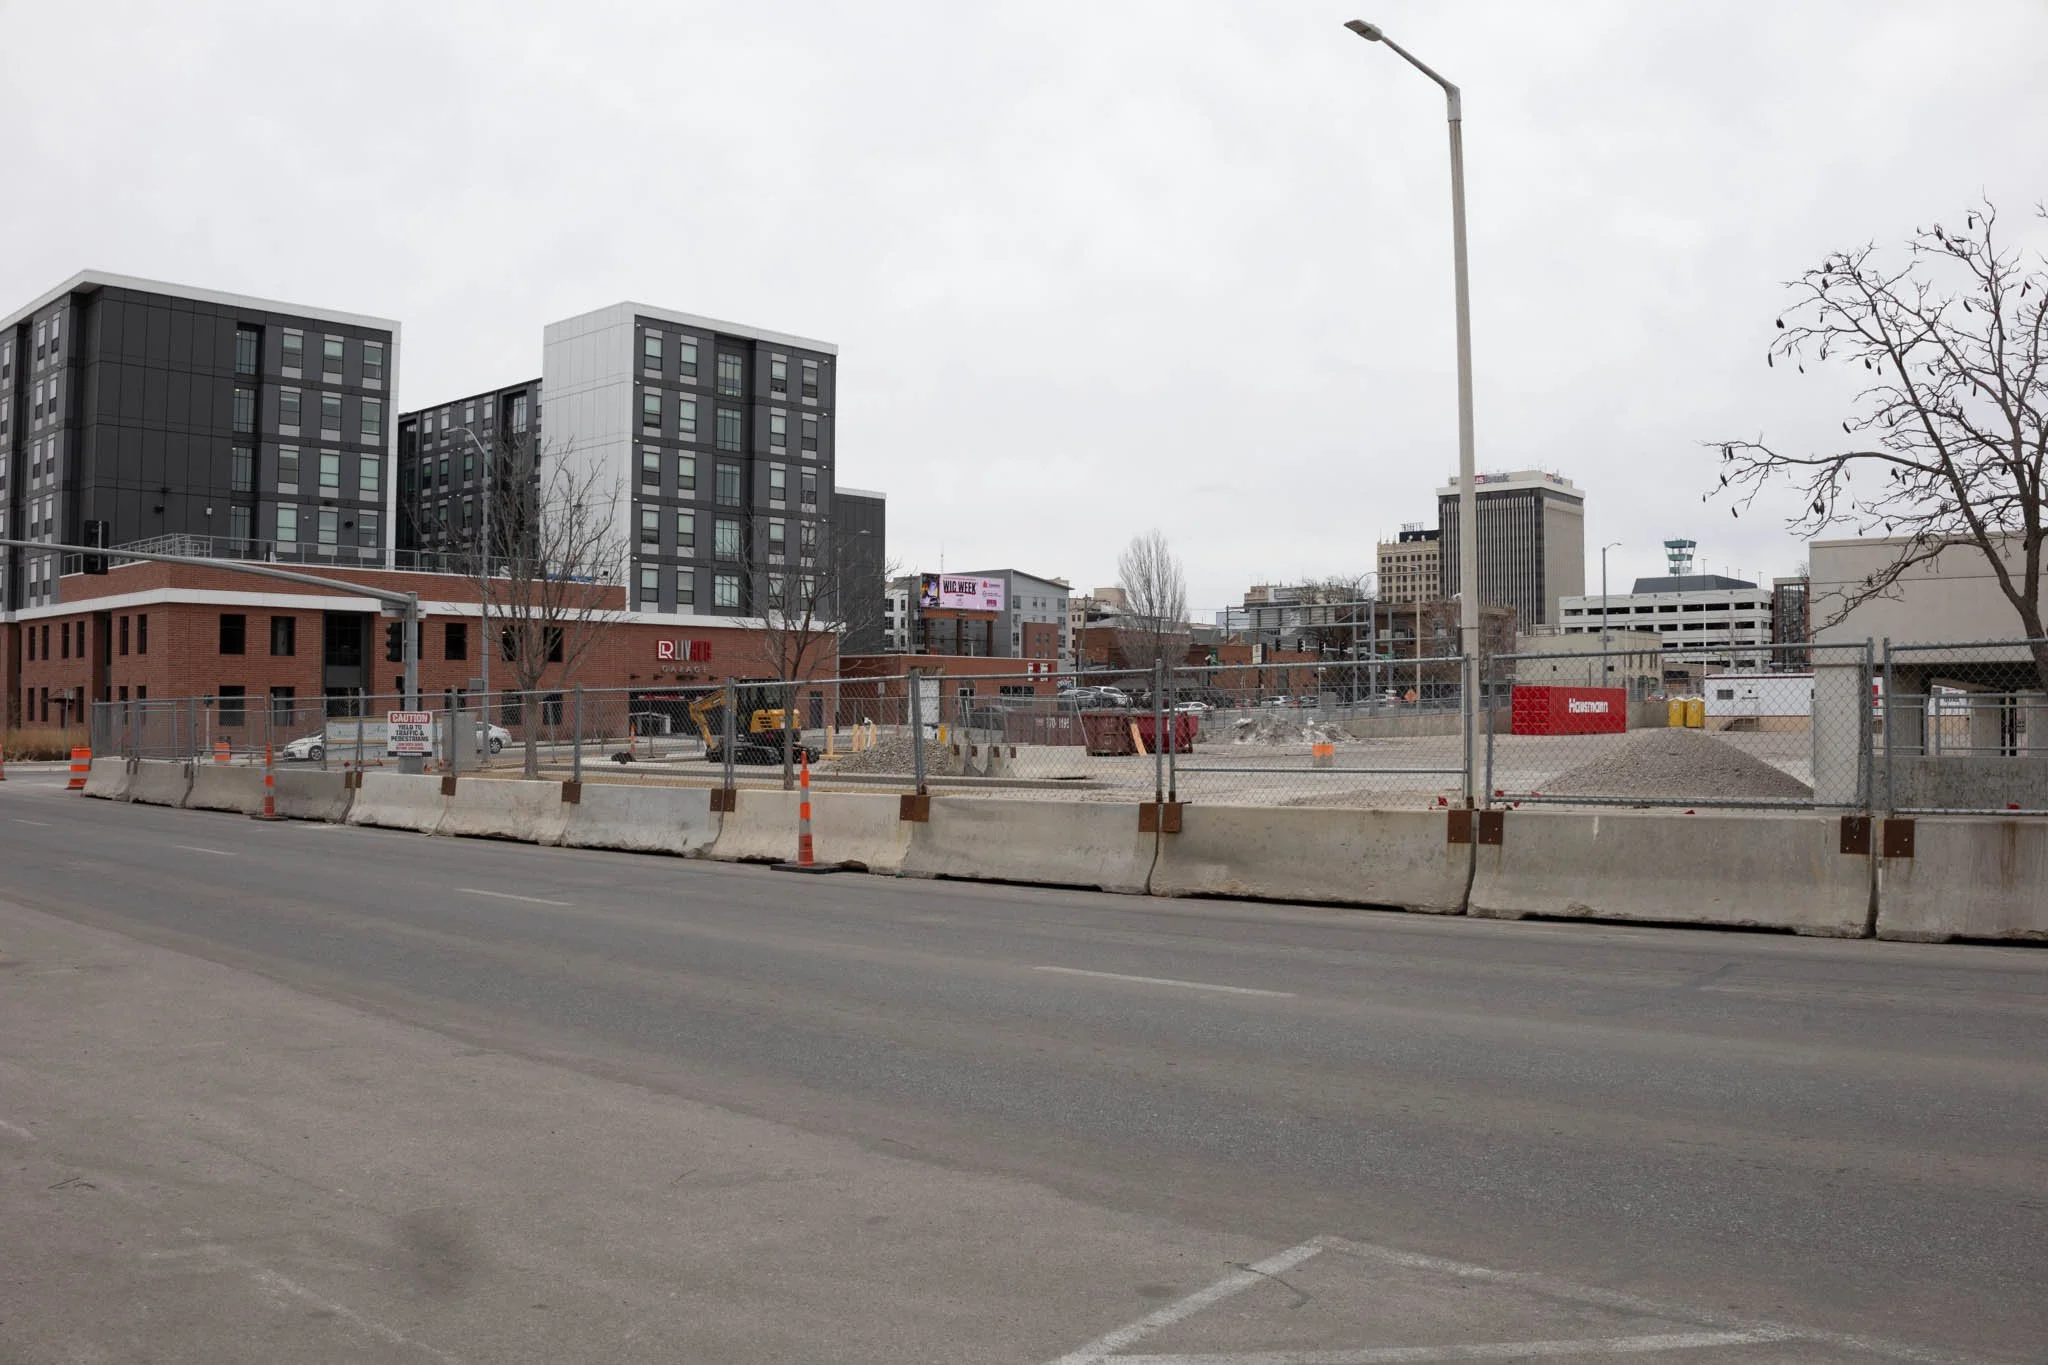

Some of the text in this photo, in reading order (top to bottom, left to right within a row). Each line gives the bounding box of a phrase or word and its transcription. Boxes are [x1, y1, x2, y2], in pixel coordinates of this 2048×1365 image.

[943, 580, 977, 594] WIC WEEK
[1569, 698, 1608, 713] Hausmann
[392, 713, 428, 723] CAUTION
